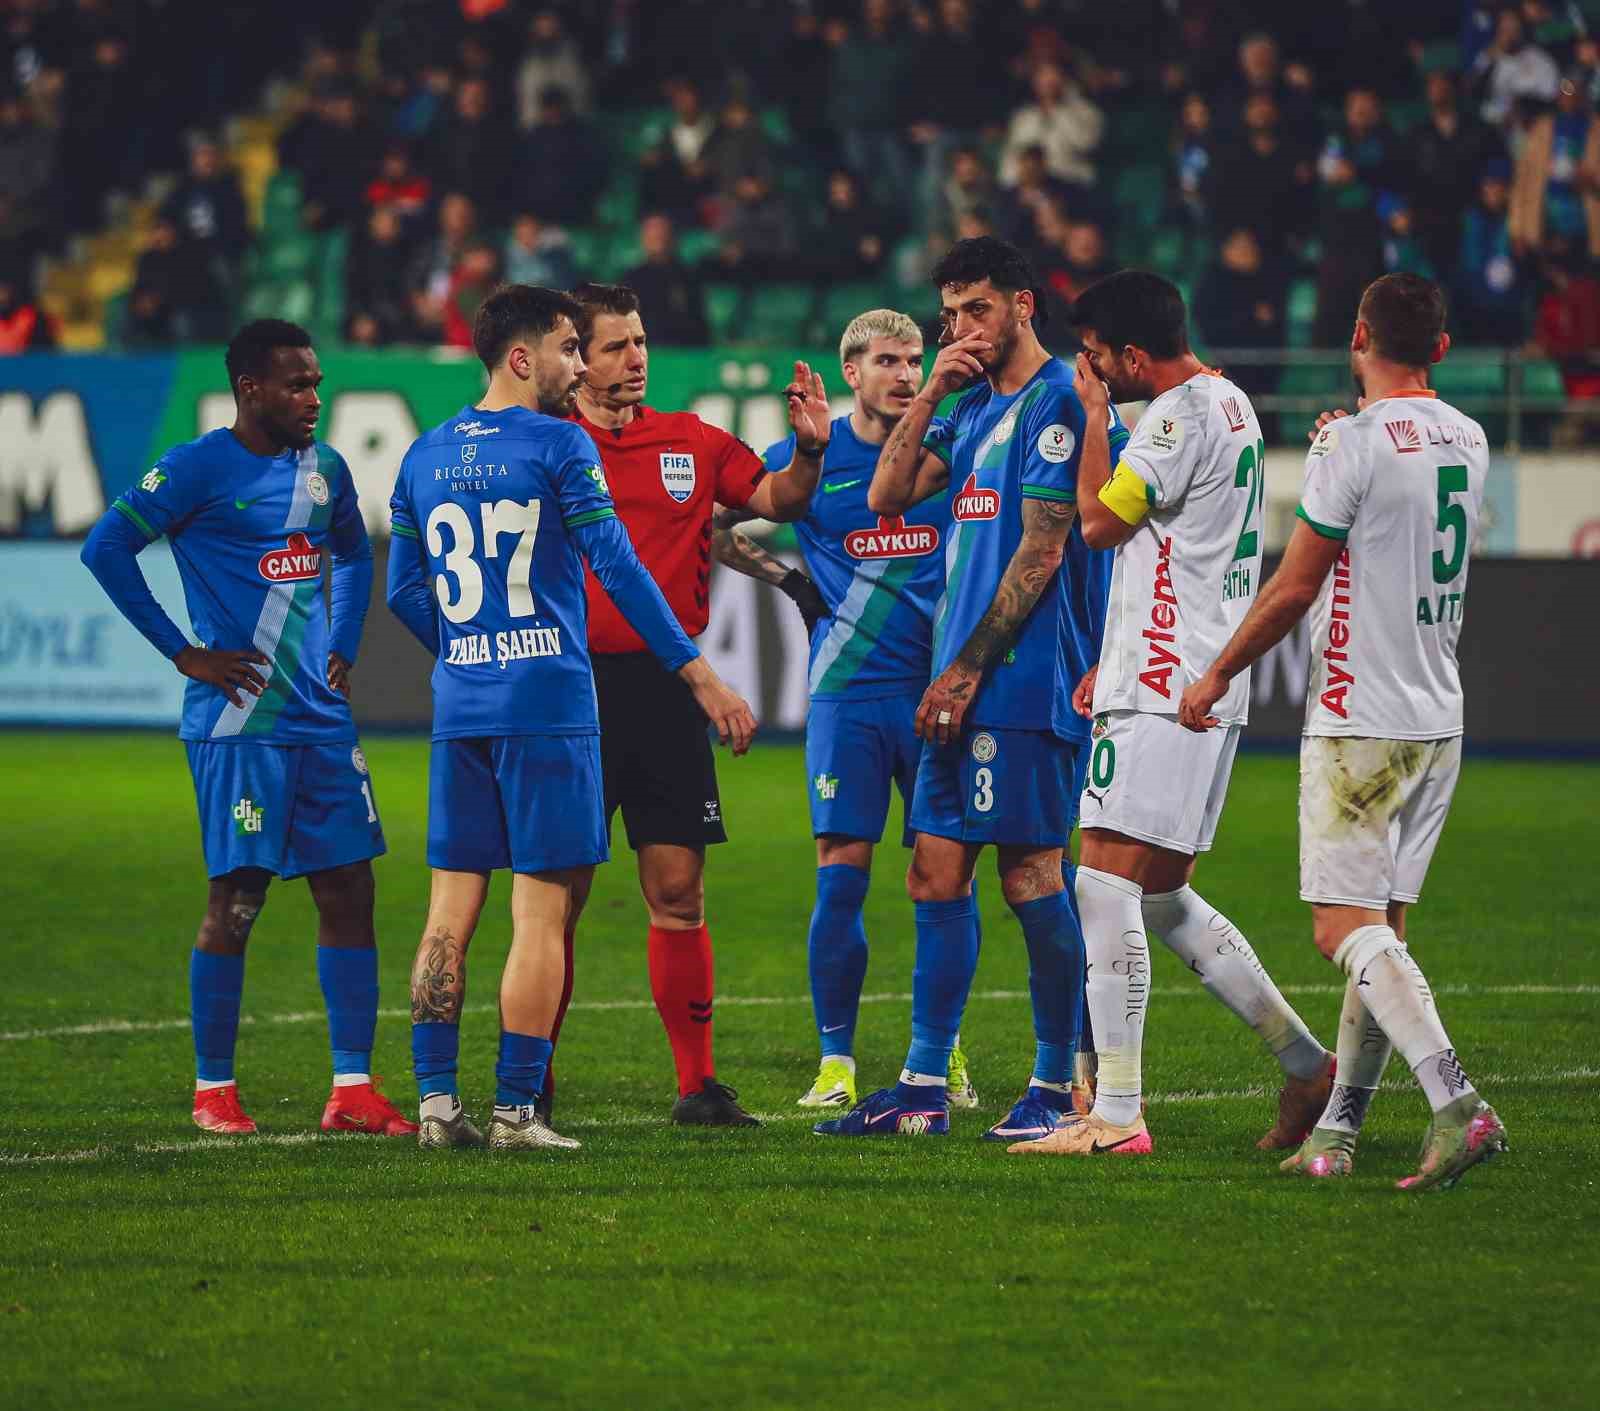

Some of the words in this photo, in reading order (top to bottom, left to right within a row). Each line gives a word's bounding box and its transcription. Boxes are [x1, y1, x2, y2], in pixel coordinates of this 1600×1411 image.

[434, 464, 508, 480] RICOSTA
[663, 456, 690, 468] FIFA
[451, 480, 489, 492] HOTEL
[1432, 465, 1468, 585] 5
[426, 498, 541, 624] 37
[852, 533, 931, 556] ÇAYKUR
[445, 634, 492, 665] TAHA
[496, 621, 562, 669] ŞAHİN
[974, 767, 994, 812] 3
